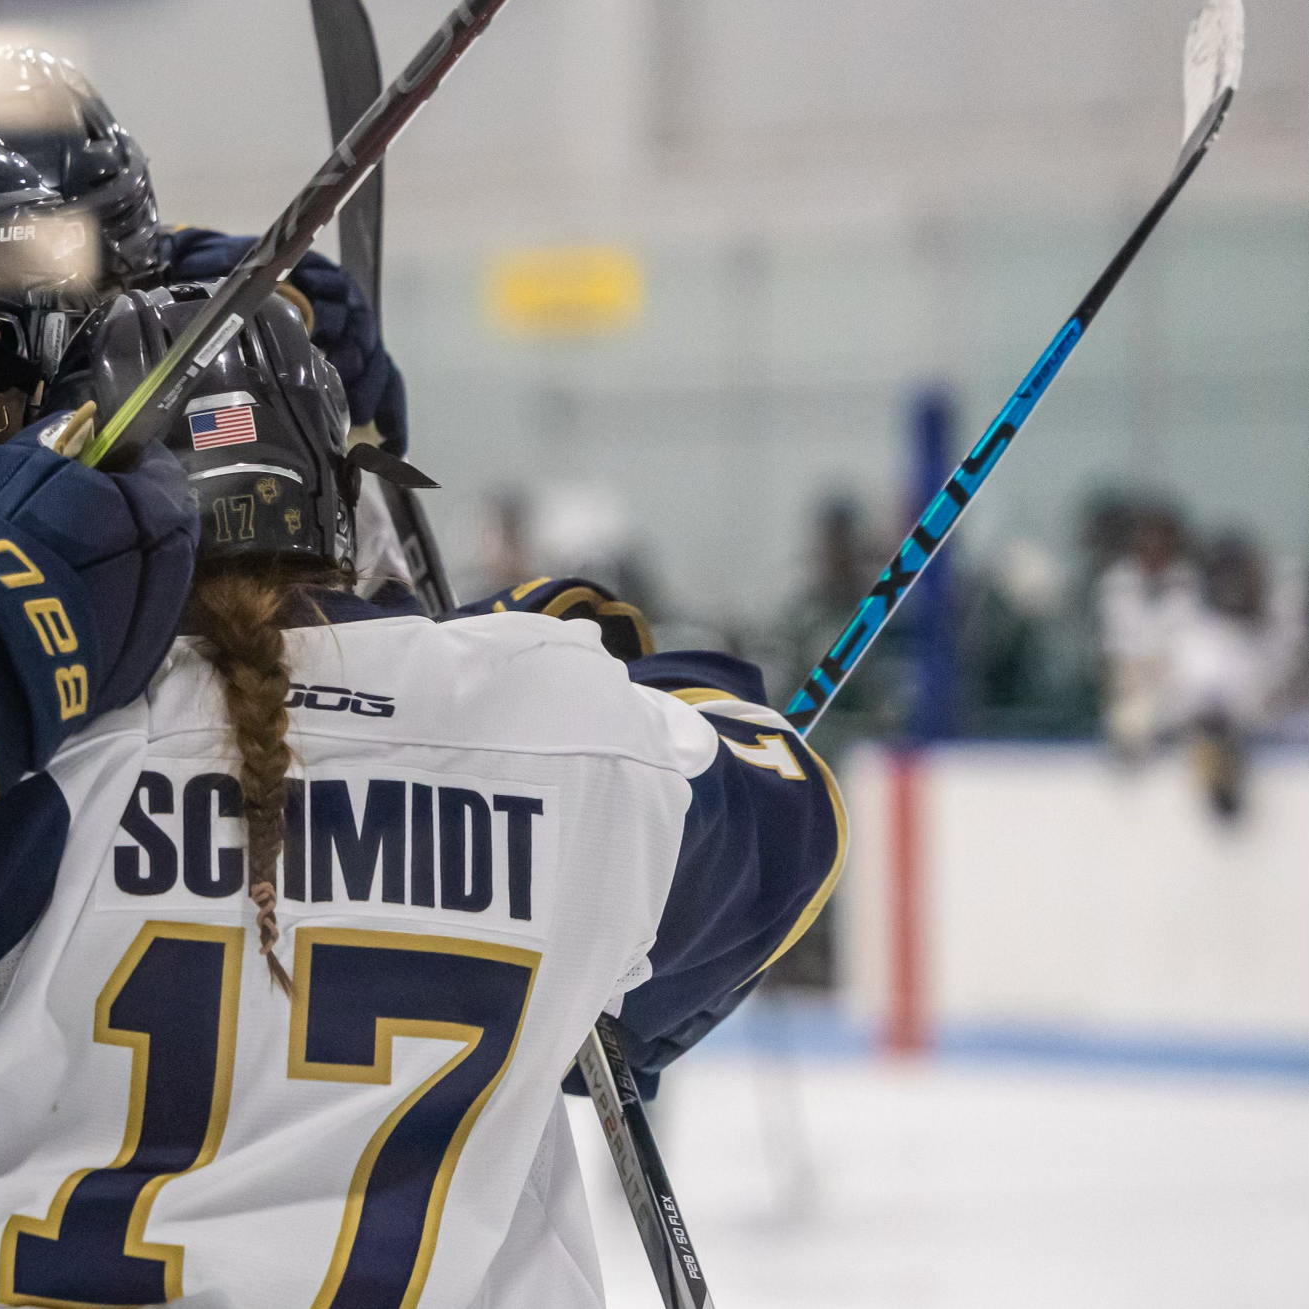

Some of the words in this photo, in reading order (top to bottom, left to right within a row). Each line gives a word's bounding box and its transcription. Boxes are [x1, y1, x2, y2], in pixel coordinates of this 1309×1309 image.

[237, 0, 476, 272] VAPO
[212, 494, 255, 542] 17
[660, 1195, 684, 1227] FLEX
[682, 1256, 702, 1281] P28
